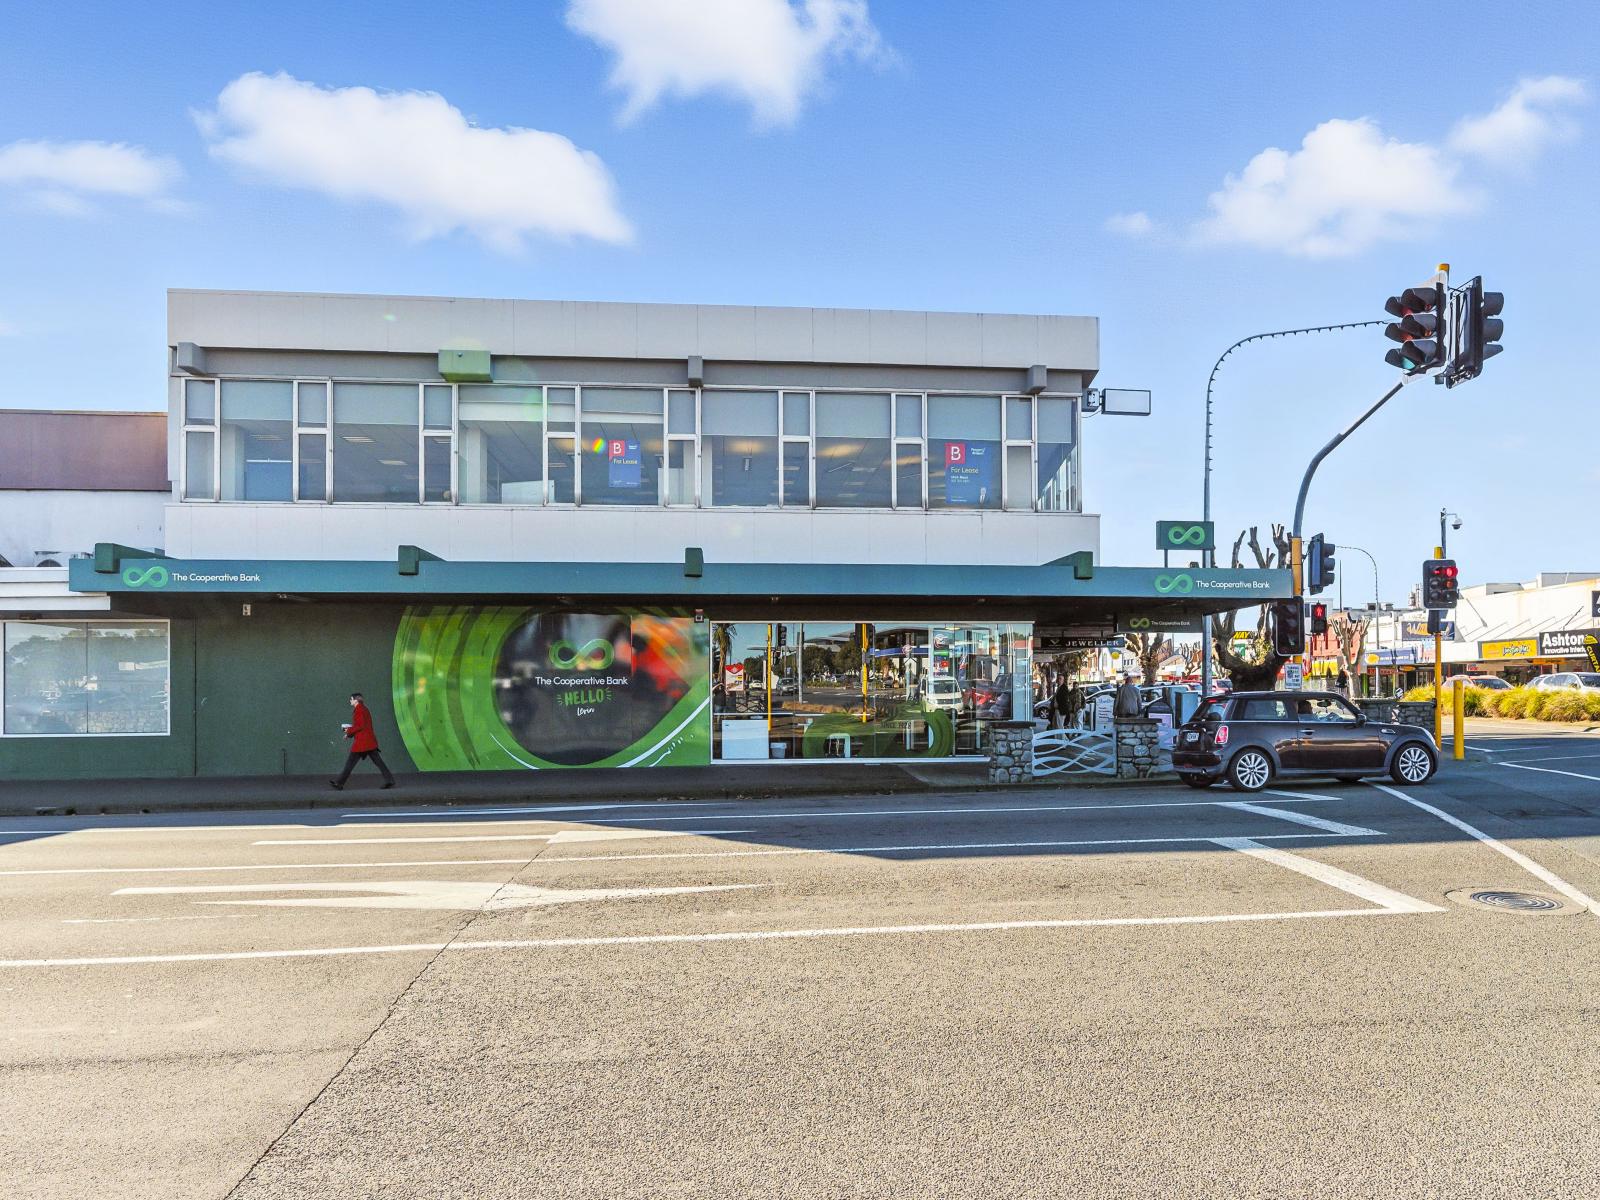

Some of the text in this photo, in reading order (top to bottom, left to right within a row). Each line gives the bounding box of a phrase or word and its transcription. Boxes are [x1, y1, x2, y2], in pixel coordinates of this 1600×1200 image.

[613, 442, 622, 454] B
[950, 446, 961, 461] B
[961, 466, 979, 474] Lease
[171, 572, 261, 583] The Cooperative Bank
[1196, 580, 1270, 590] The Cooperative Bank
[1586, 645, 1600, 673] CURTA
[535, 676, 628, 687] The Cooperative Bank
[564, 689, 604, 707] HELLO
